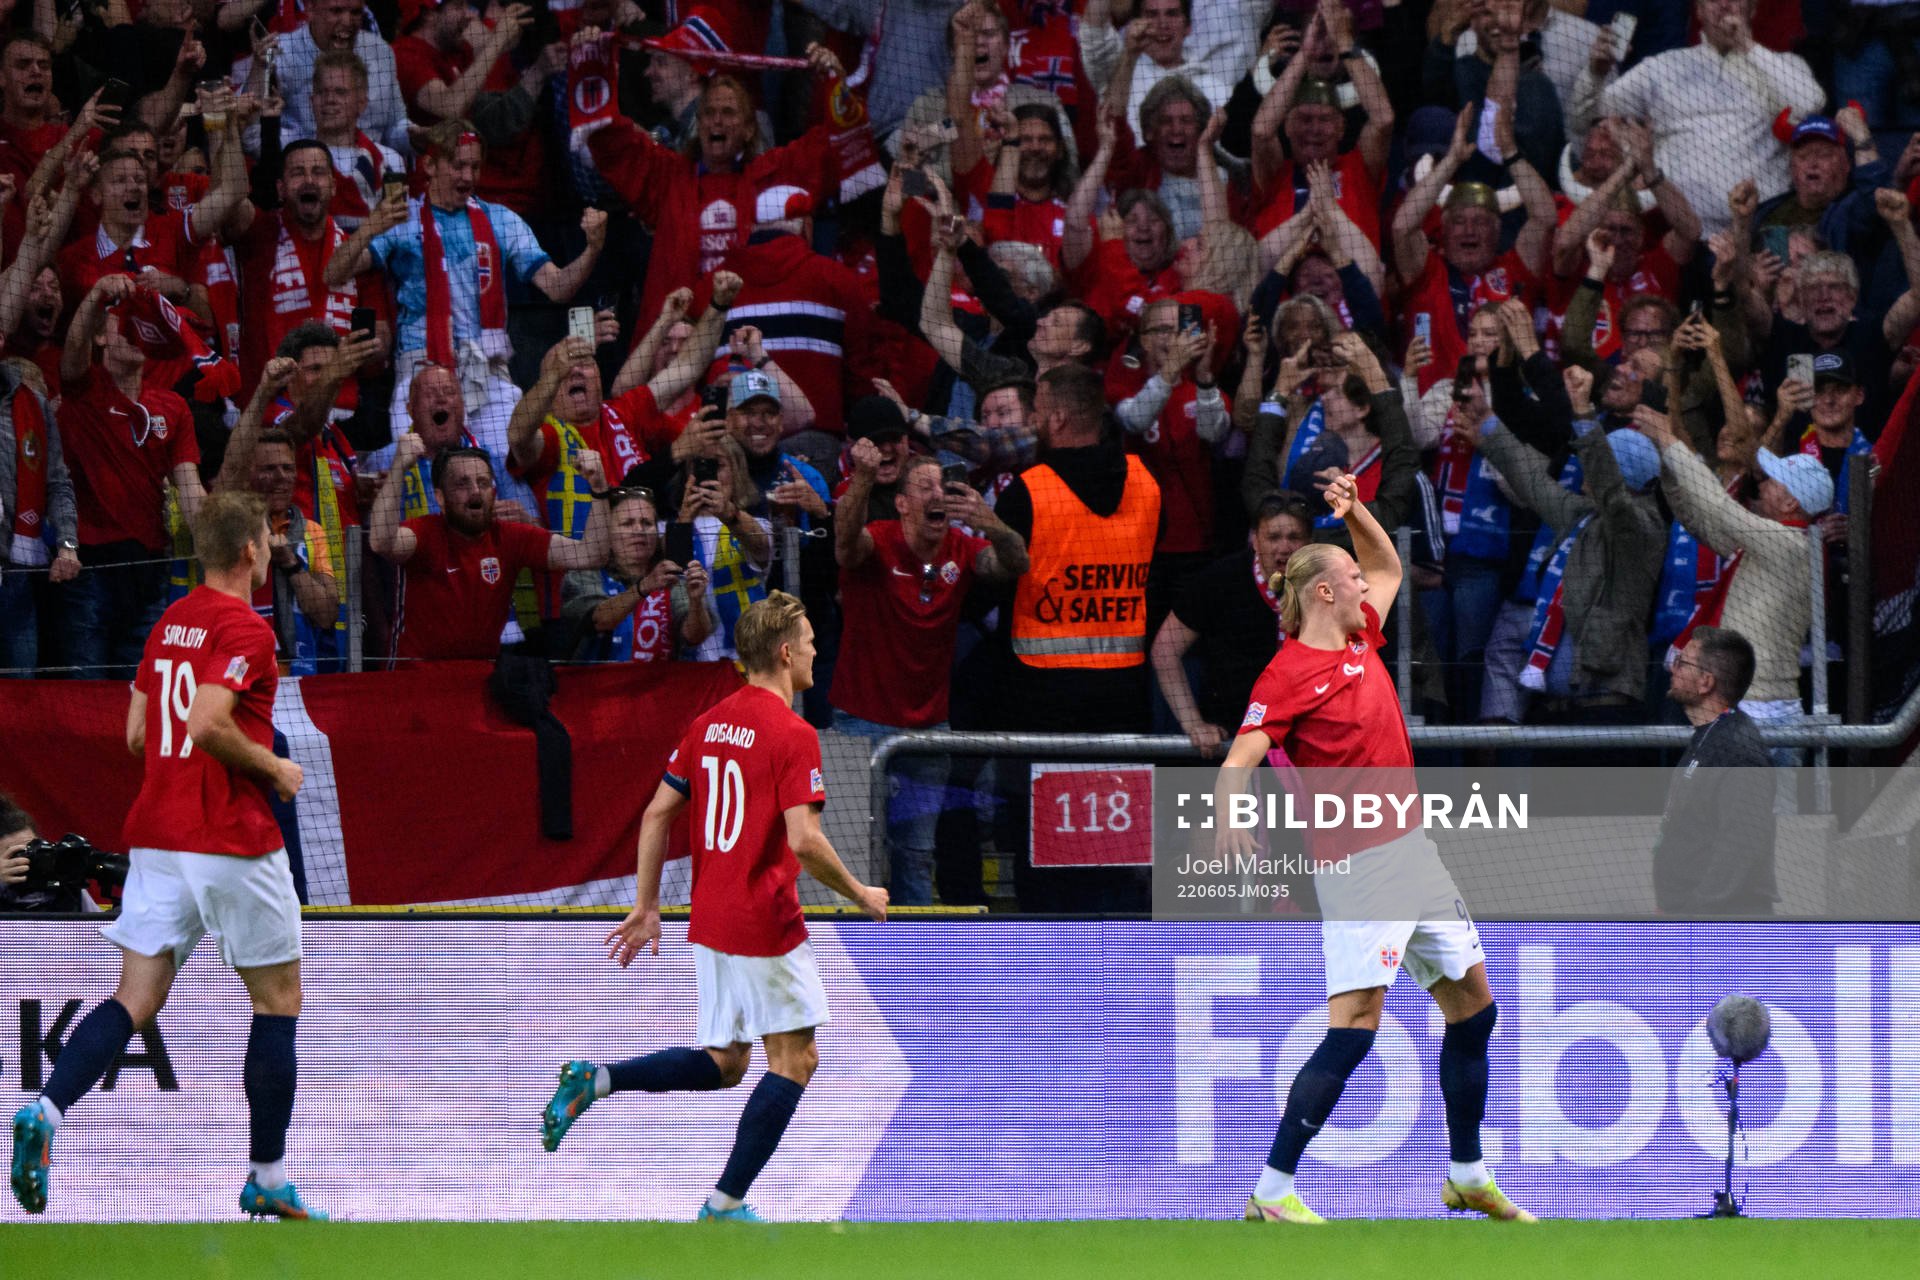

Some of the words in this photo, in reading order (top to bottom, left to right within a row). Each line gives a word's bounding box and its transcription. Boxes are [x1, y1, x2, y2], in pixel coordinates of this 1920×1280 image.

[1064, 562, 1149, 591] SERVIC
[1070, 596, 1143, 623] SAFET
[154, 658, 198, 759] 19
[702, 755, 745, 853] 10
[1055, 790, 1132, 833] 118
[0, 999, 180, 1091] KA
